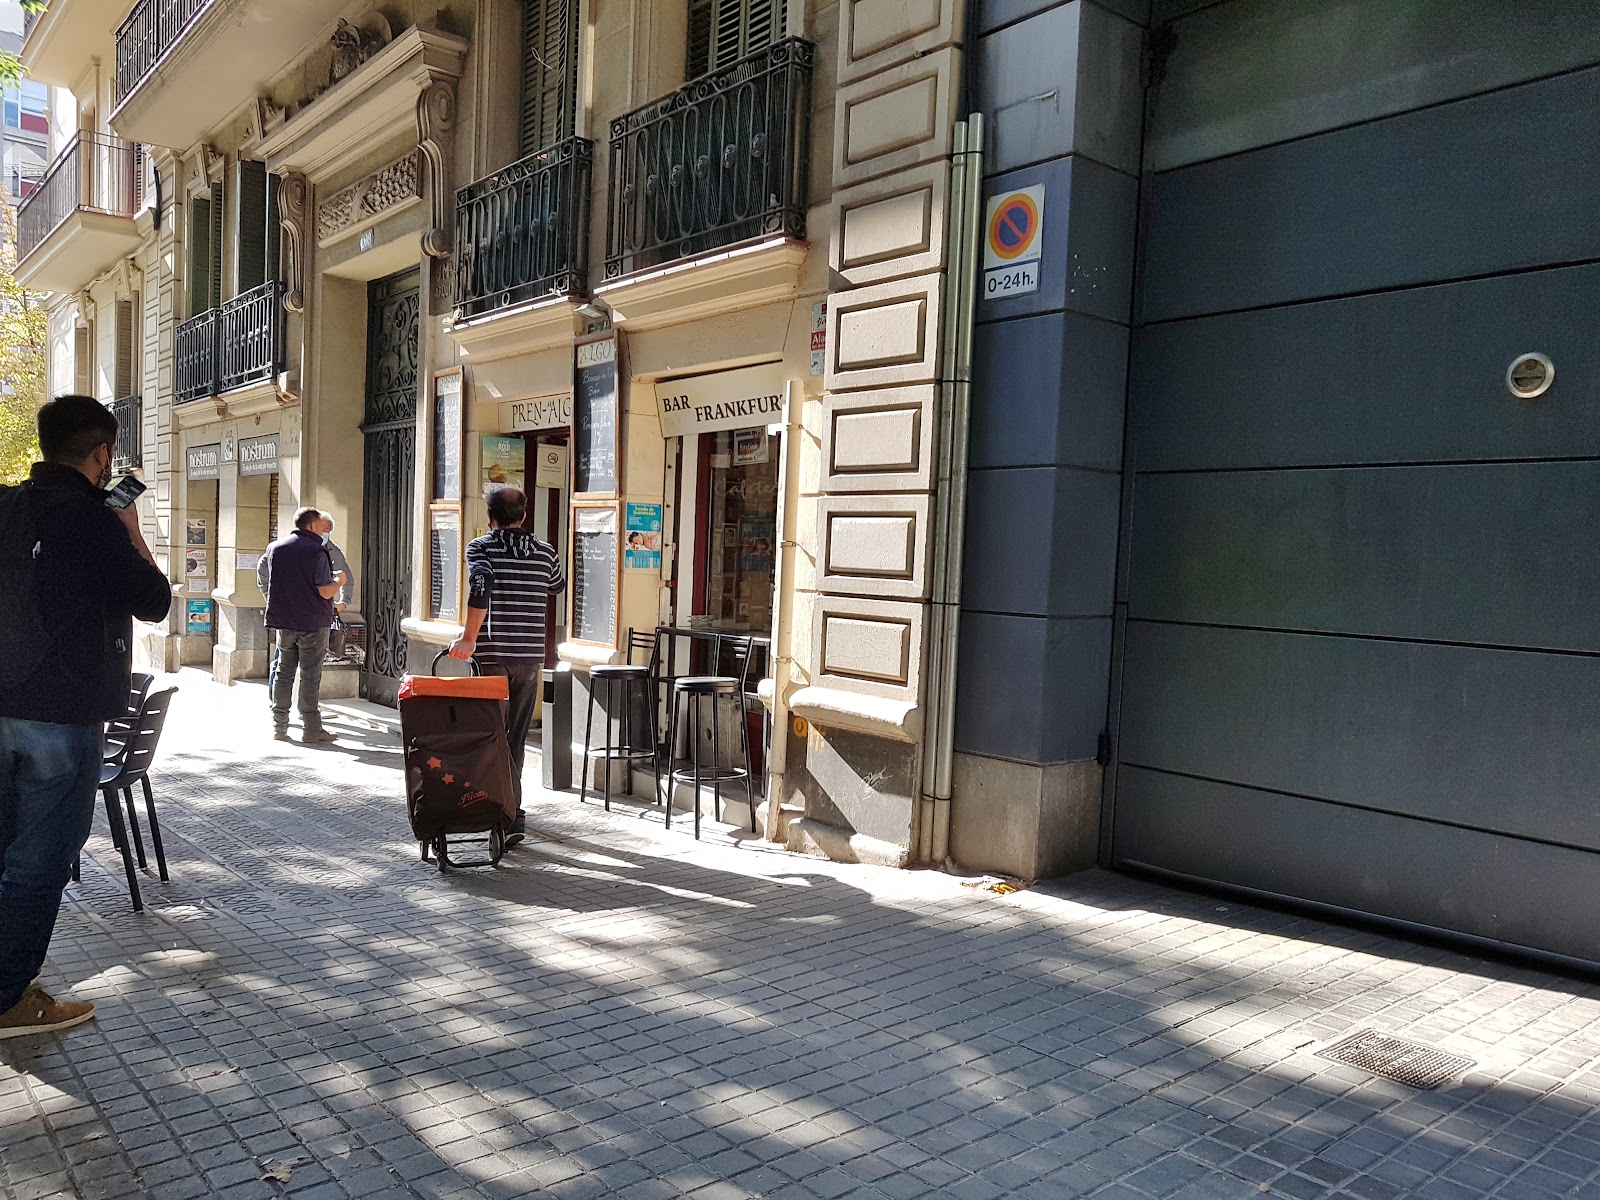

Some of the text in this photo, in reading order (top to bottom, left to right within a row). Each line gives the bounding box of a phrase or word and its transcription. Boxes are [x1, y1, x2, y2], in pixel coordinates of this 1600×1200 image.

[988, 271, 1034, 293] 0-24h.
[662, 394, 784, 422] BAR FRANKFUR
[189, 449, 218, 468] nostrum
[240, 440, 277, 462] nostrum
